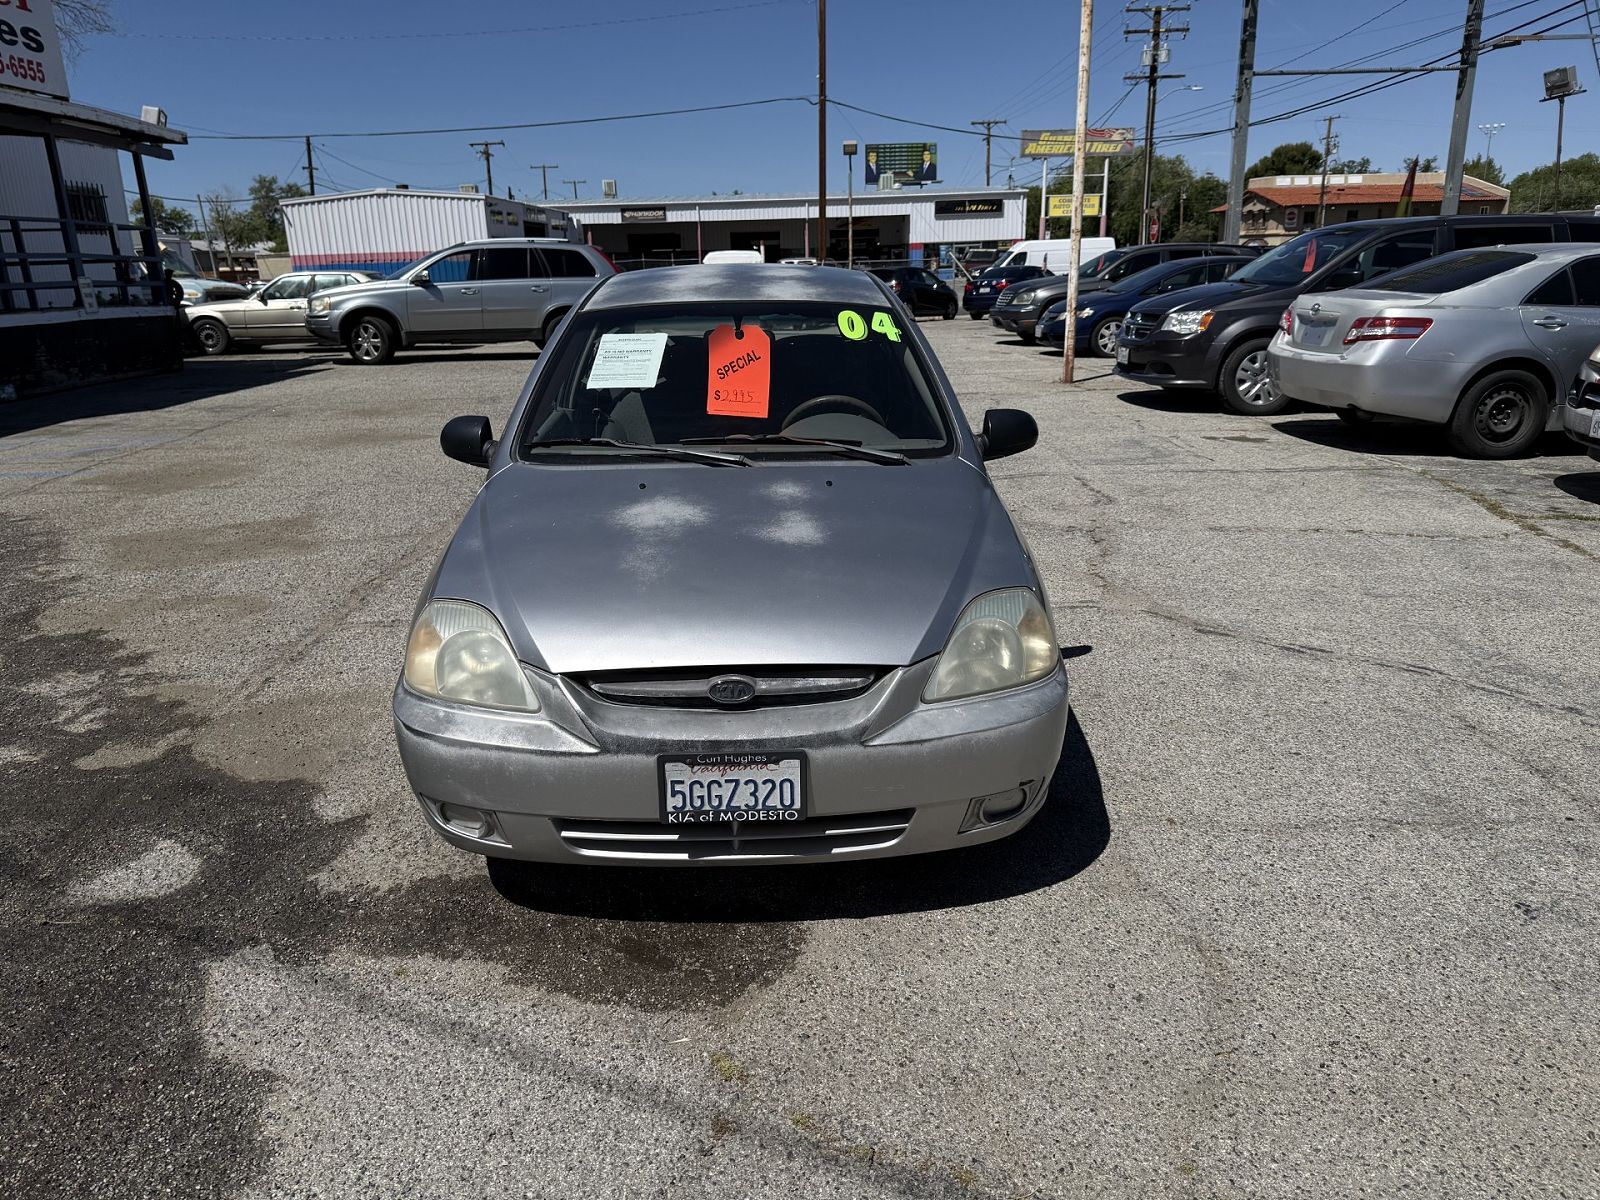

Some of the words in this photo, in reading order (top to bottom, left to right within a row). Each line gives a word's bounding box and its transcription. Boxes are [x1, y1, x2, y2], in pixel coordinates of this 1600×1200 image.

[837, 310, 902, 343] 04
[716, 350, 761, 380] SPECIAL
[716, 684, 747, 696] KIA
[725, 754, 767, 764] Hughes
[669, 778, 795, 812] 5GGZ320
[668, 813, 694, 824] KIA
[700, 812, 714, 823] of
[719, 810, 798, 822] MODESTO
